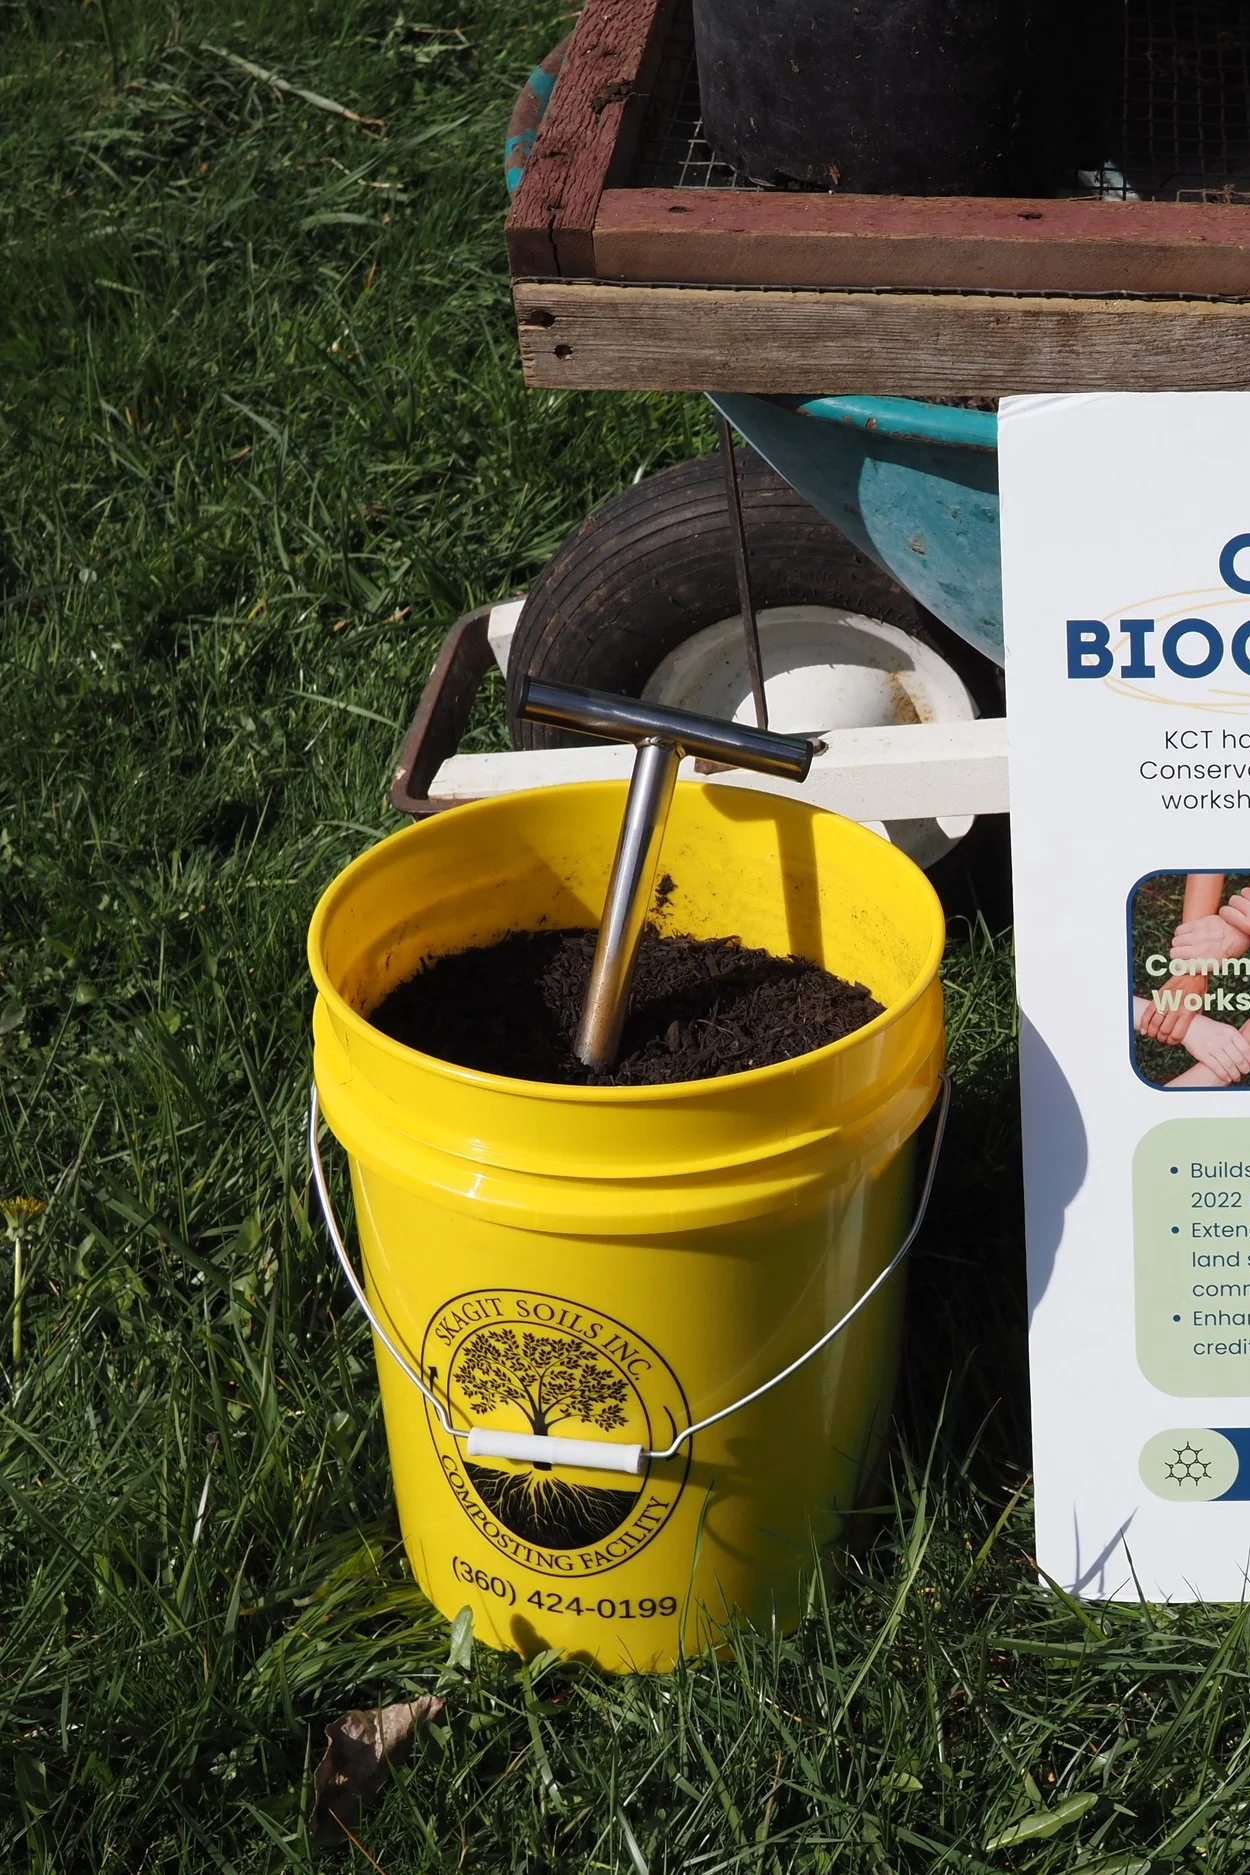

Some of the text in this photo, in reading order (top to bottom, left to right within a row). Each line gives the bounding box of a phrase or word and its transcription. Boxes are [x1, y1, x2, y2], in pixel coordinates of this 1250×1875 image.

[1165, 730, 1213, 750] KCT
[1191, 1191, 1242, 1209] 2022
[1192, 1250, 1240, 1268] land
[435, 1297, 652, 1381] SKAGIT SOILS INC.
[441, 1454, 670, 1572] COMPOSTING FACILITY
[452, 1556, 678, 1619] (360) 424-0199
